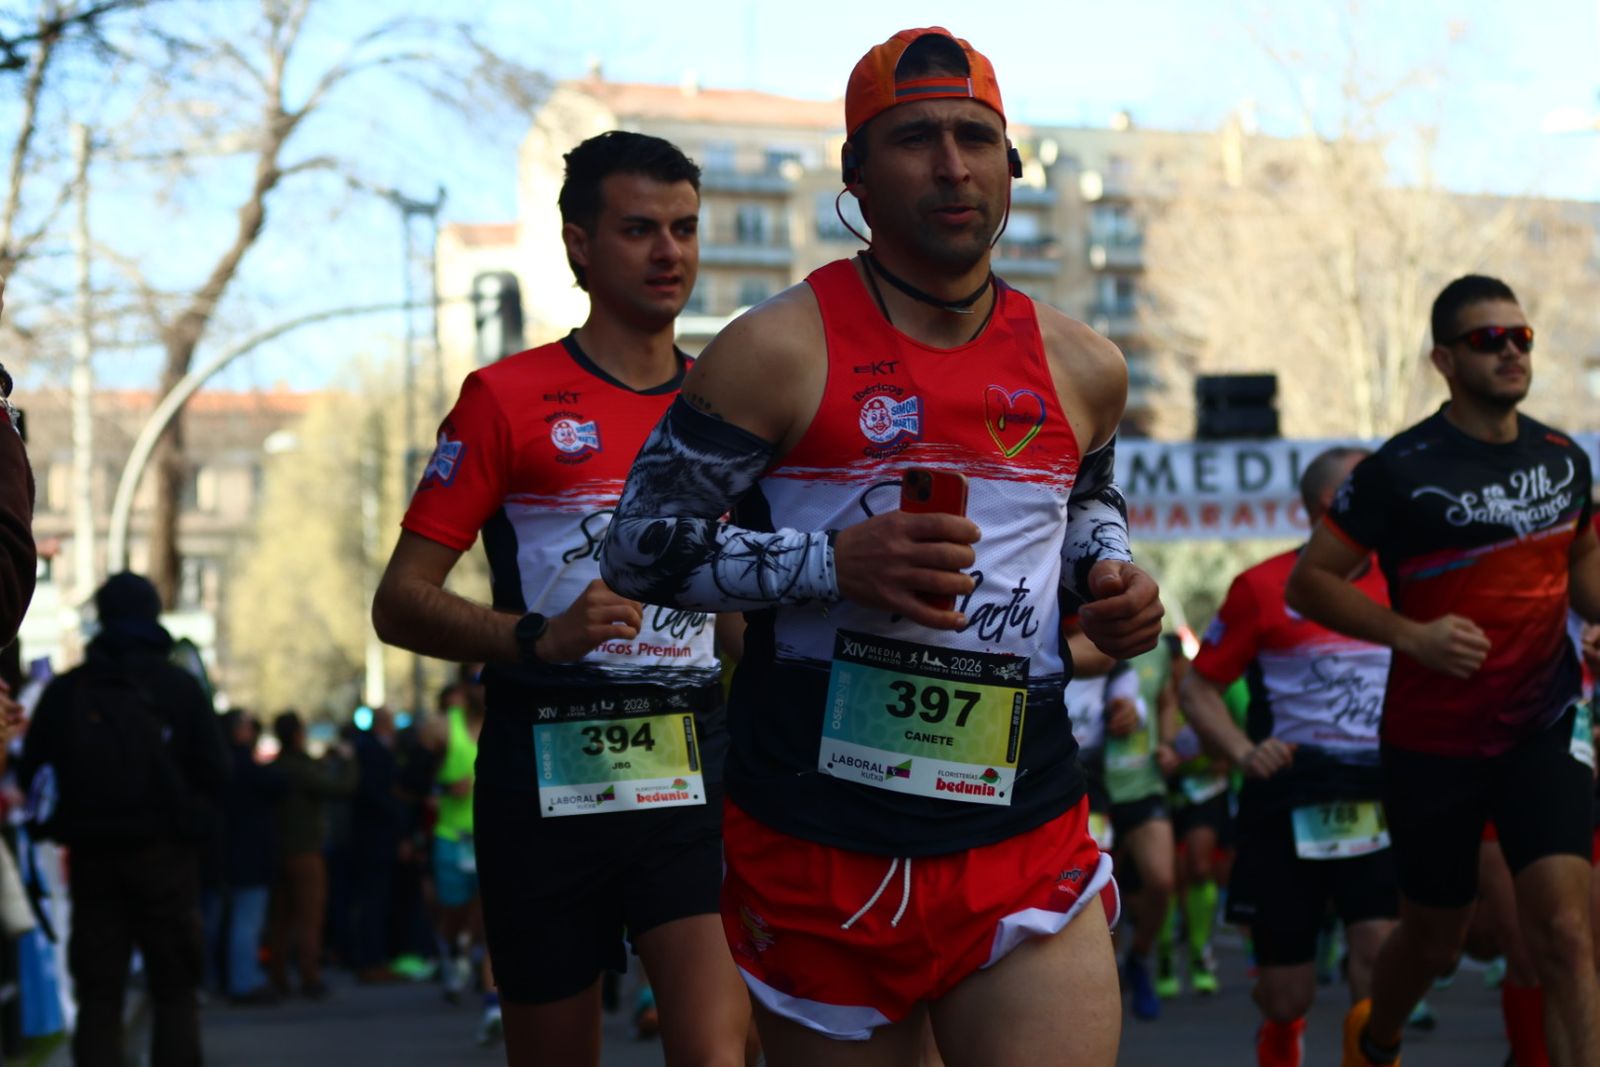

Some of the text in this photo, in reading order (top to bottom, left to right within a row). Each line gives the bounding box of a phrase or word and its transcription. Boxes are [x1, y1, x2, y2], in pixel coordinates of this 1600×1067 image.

[1127, 448, 1301, 493] MEDI
[1128, 500, 1310, 530] MARATO
[842, 638, 869, 659] XIV
[867, 646, 902, 660] MEDIA
[951, 656, 982, 673] 2026
[537, 706, 558, 720] XIV
[623, 698, 650, 711] 2026
[886, 680, 981, 728] 397
[579, 722, 656, 757] 394
[904, 730, 955, 747] CANETE
[611, 761, 632, 771] JBG
[831, 752, 885, 775] LABORAL
[860, 771, 885, 783] kutxa
[935, 777, 996, 797] bedunia
[550, 793, 595, 806] LABORAL
